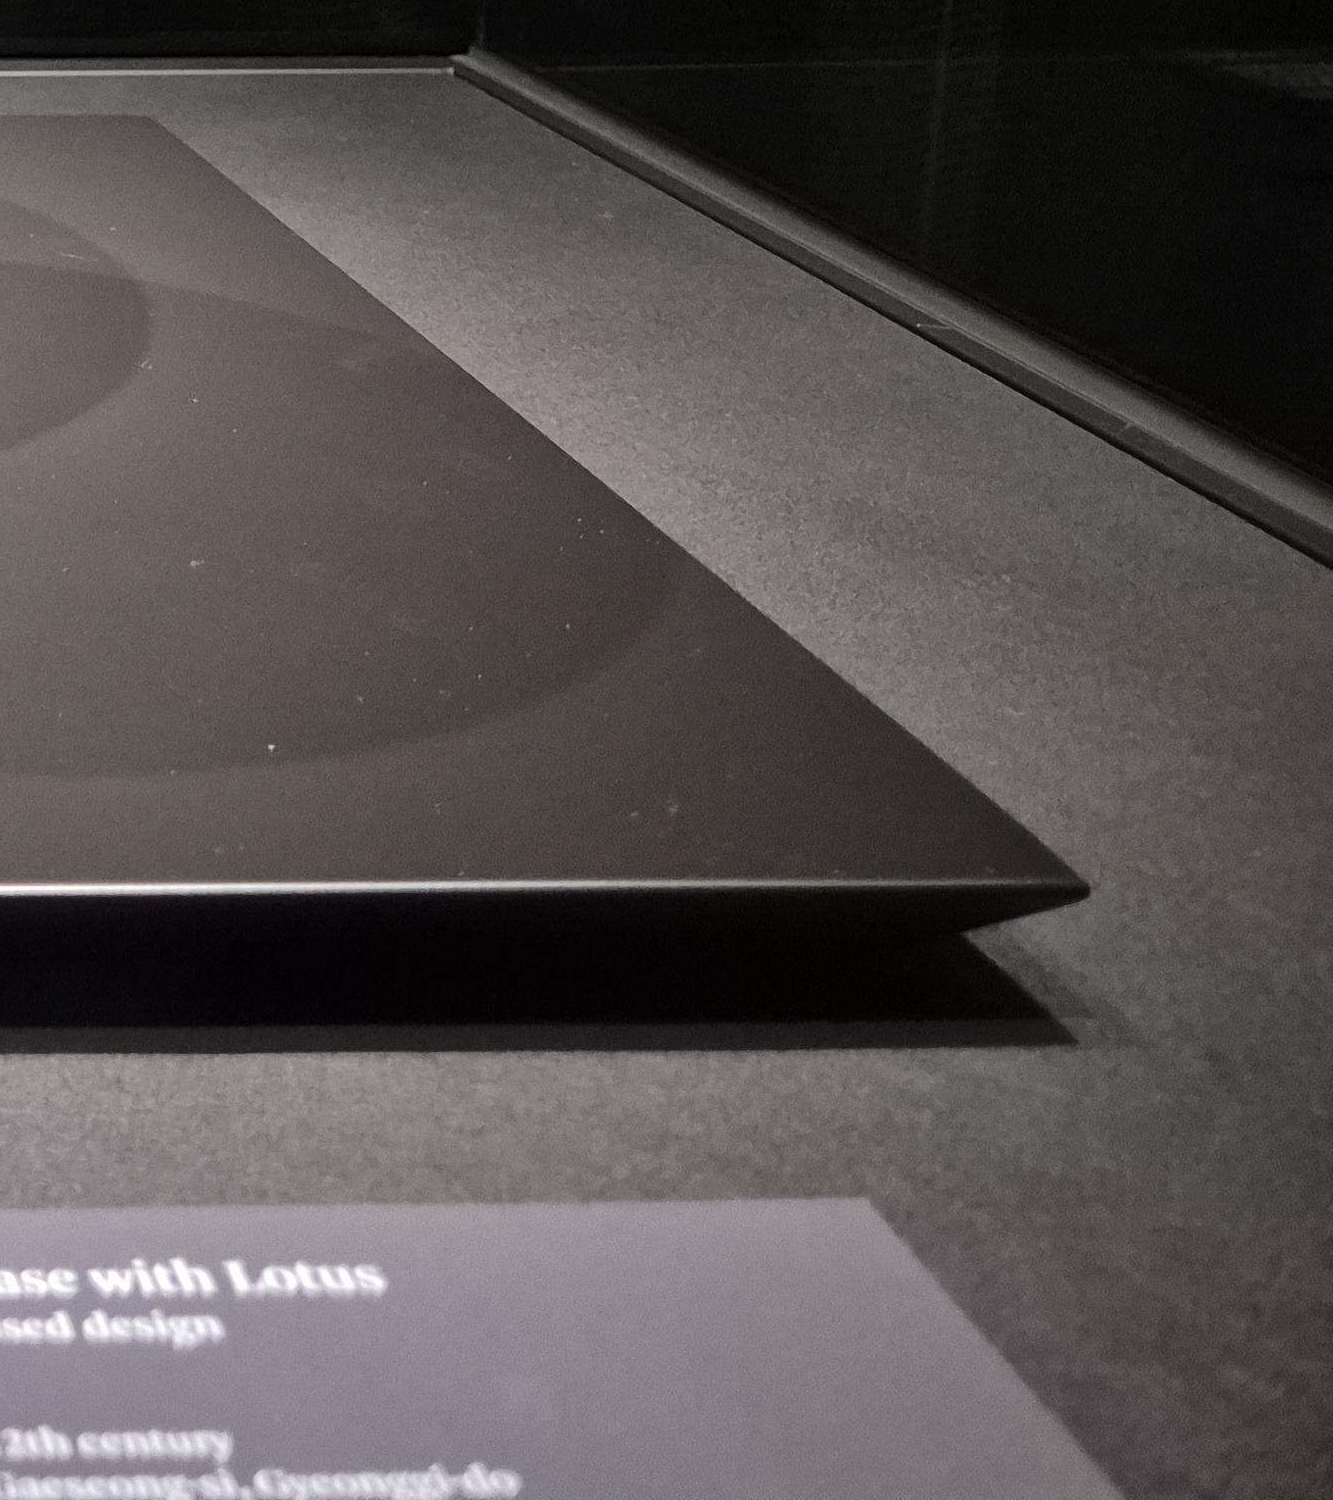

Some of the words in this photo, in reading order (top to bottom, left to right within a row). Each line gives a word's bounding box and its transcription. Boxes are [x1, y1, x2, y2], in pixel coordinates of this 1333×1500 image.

[87, 1256, 218, 1298] with
[222, 1258, 389, 1298] Lotus
[82, 1309, 225, 1348] design
[76, 1430, 231, 1464] century
